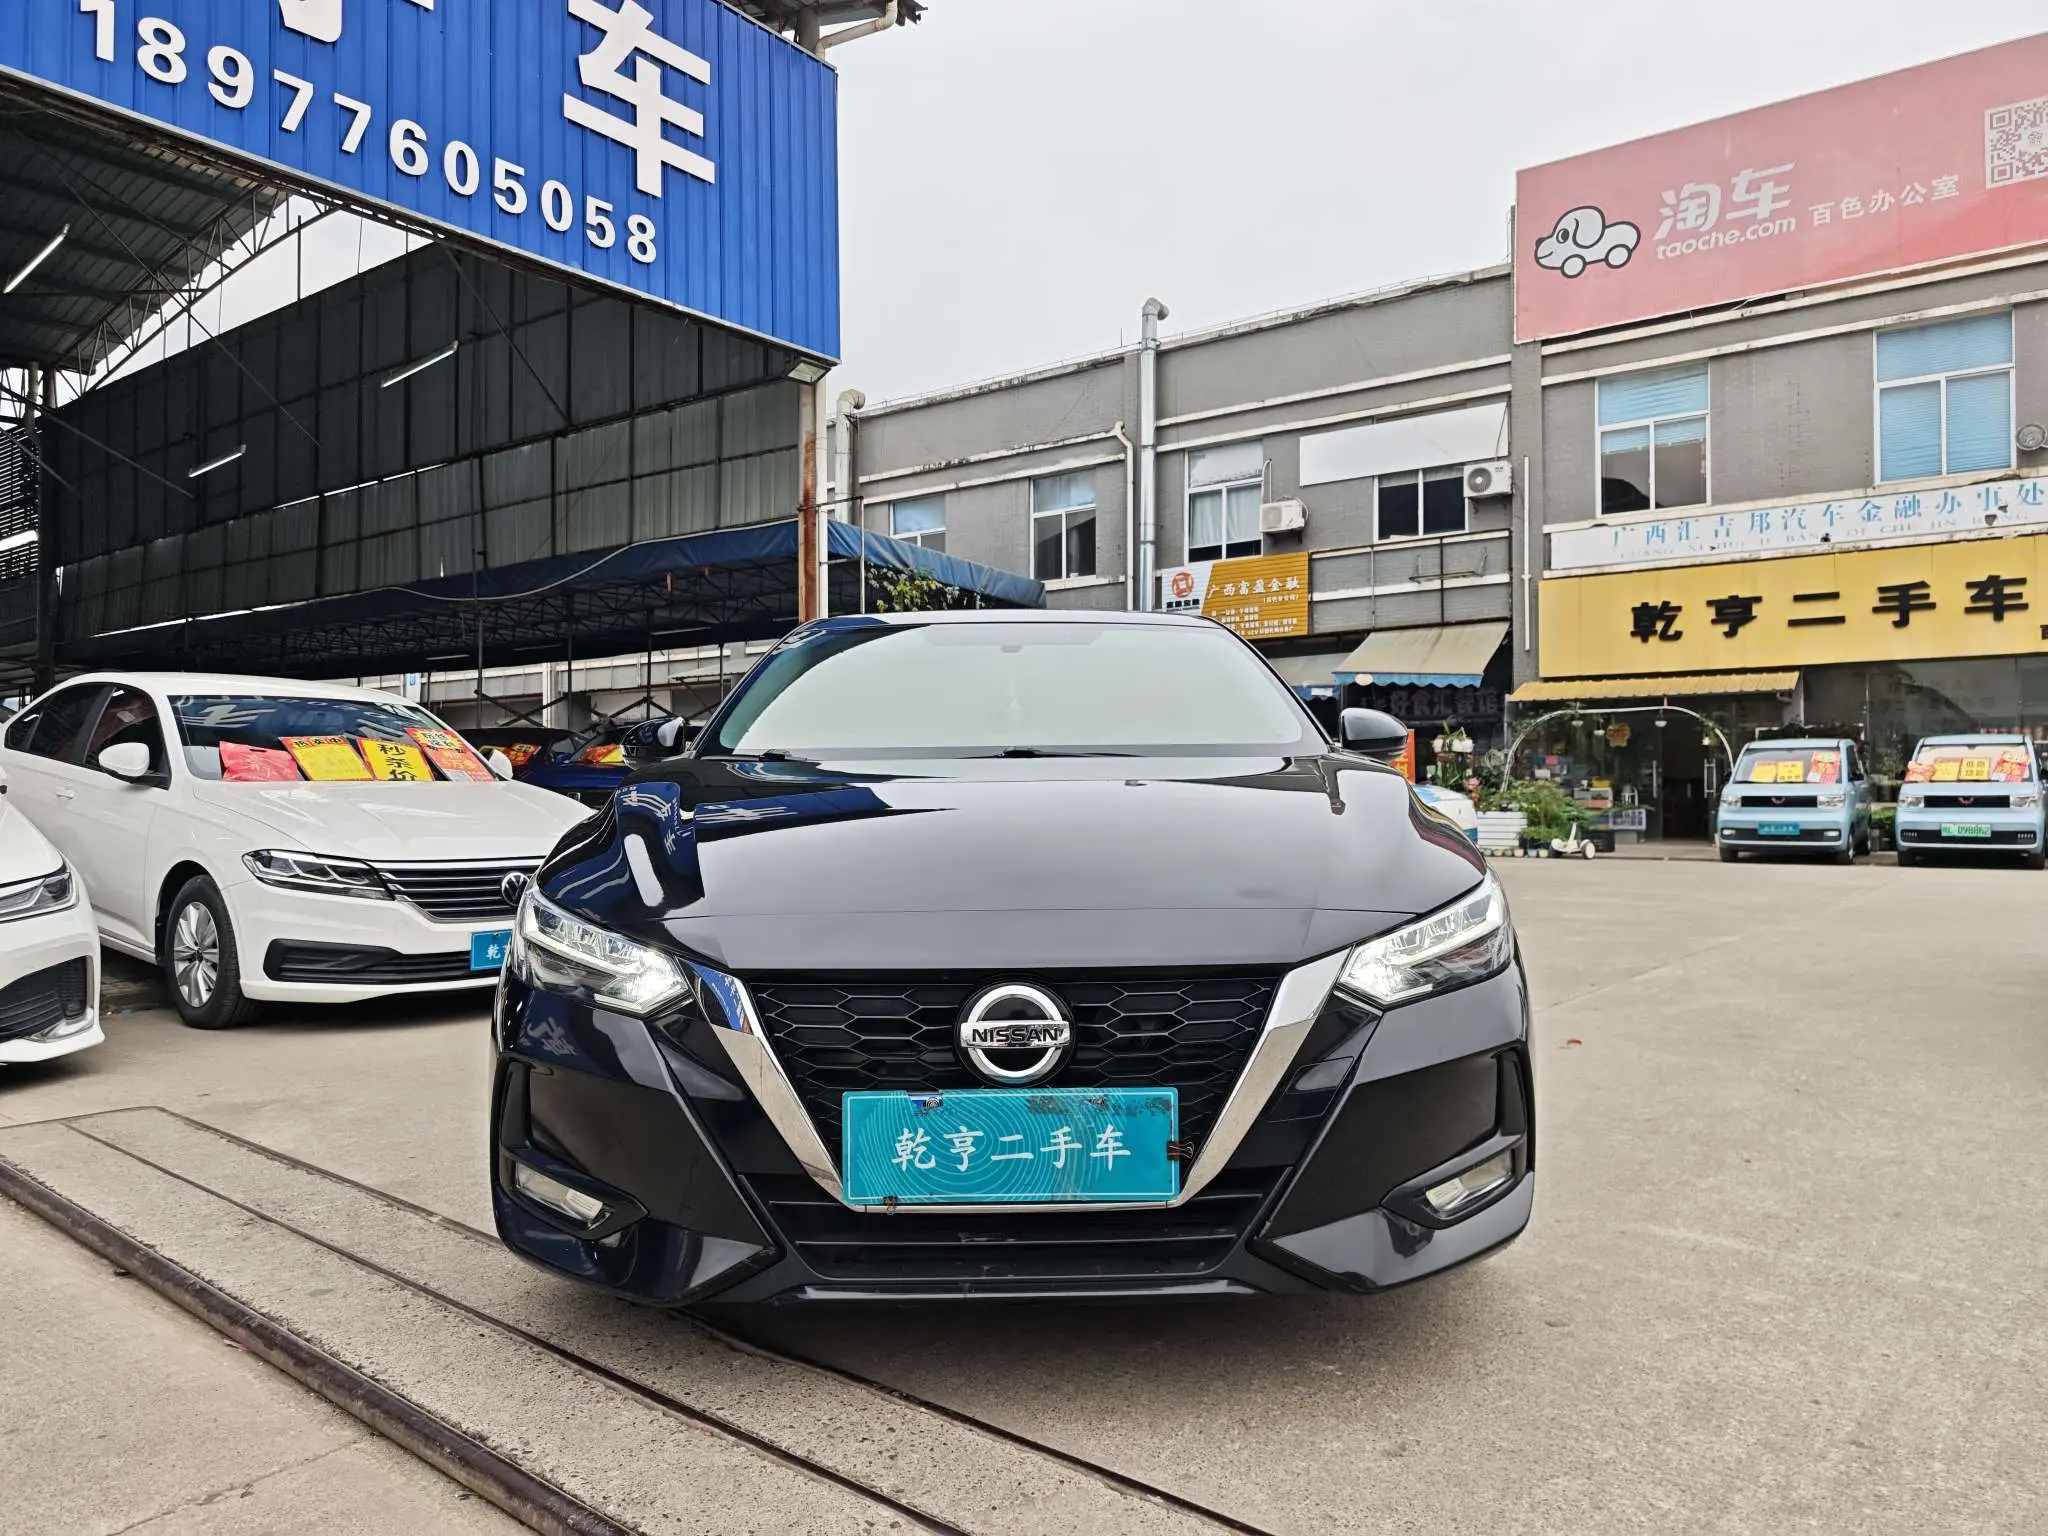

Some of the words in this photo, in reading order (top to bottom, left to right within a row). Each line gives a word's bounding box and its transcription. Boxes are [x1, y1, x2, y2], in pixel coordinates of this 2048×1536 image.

[78, 0, 659, 265] 18977605058
[1653, 161, 1796, 241] 淘车
[1808, 174, 1961, 228] 百色办公室
[1654, 216, 1797, 260] taoche.com
[1630, 575, 2030, 643] 乾亨二手车
[971, 1026, 1061, 1045] NISSAN
[891, 1125, 1132, 1172] 乾亨二手车
